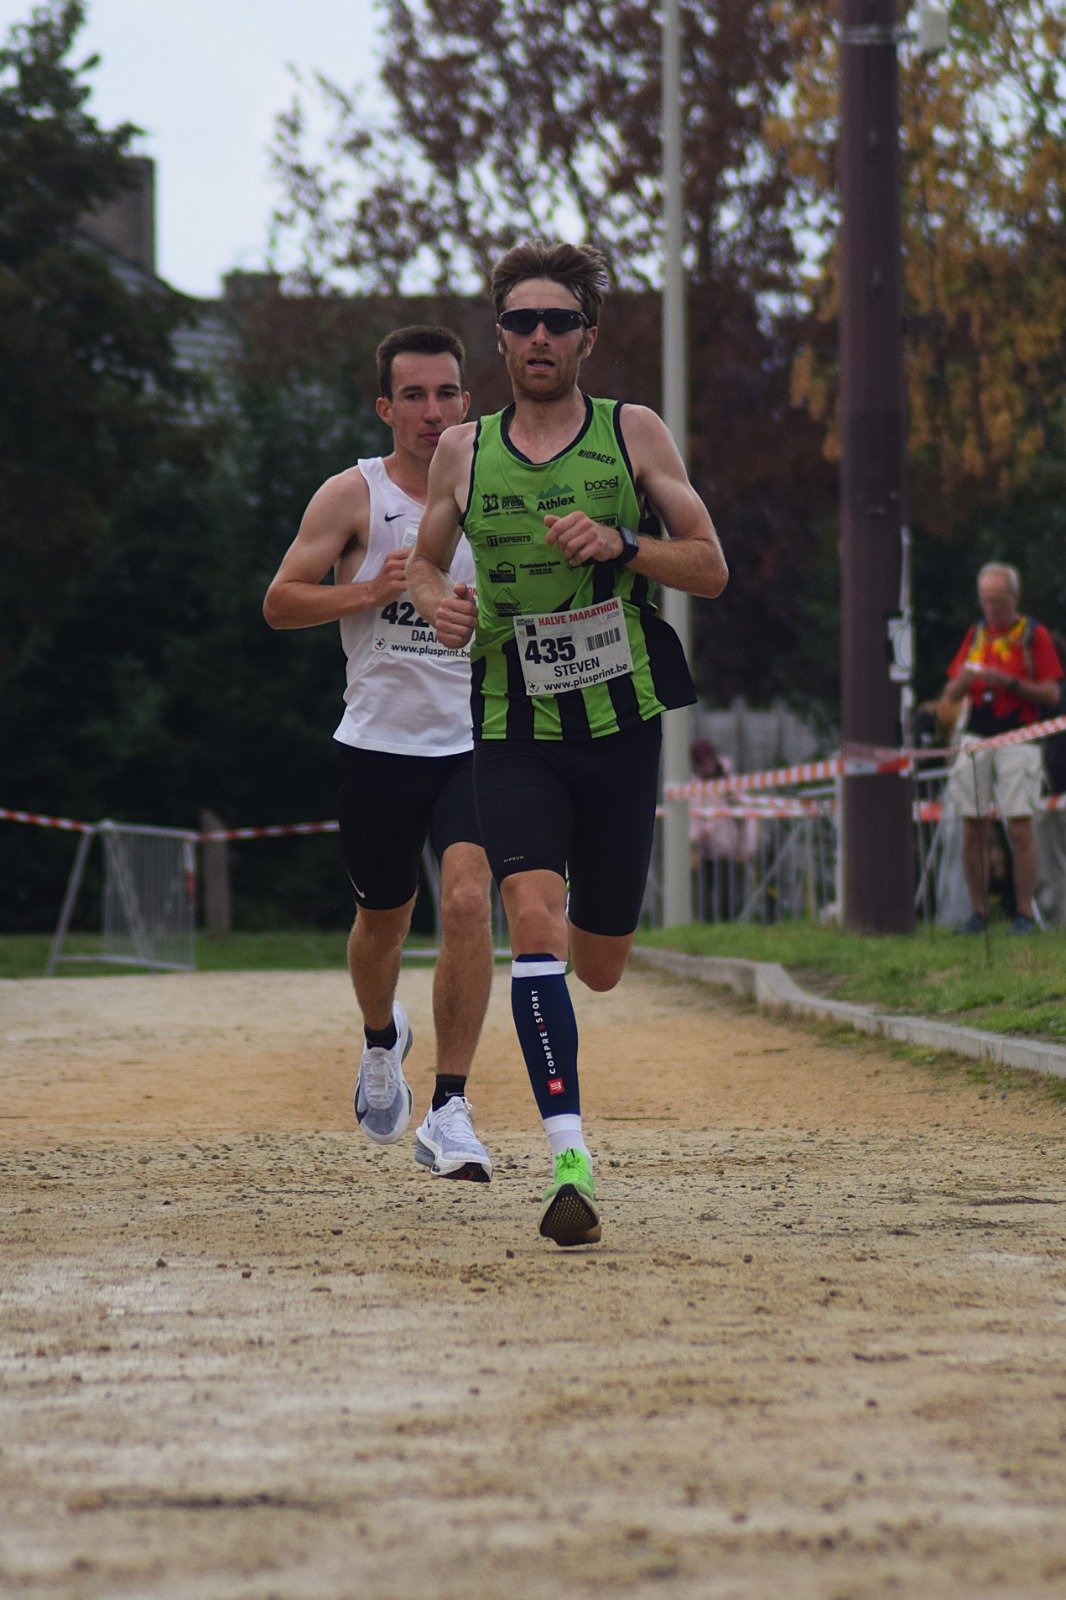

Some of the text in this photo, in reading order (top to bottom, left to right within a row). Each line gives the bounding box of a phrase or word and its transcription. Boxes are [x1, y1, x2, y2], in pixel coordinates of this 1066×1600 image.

[577, 449, 617, 466] BIORACER
[536, 494, 576, 512] Athlex
[498, 535, 531, 544] EXPERTS
[538, 614, 567, 626] HALVE
[569, 600, 619, 623] MARATHON
[524, 636, 576, 665] 435
[544, 662, 628, 691] www.plusprint.be
[554, 656, 601, 678] STEVEN
[531, 989, 556, 1075] COMPRESSPORT
